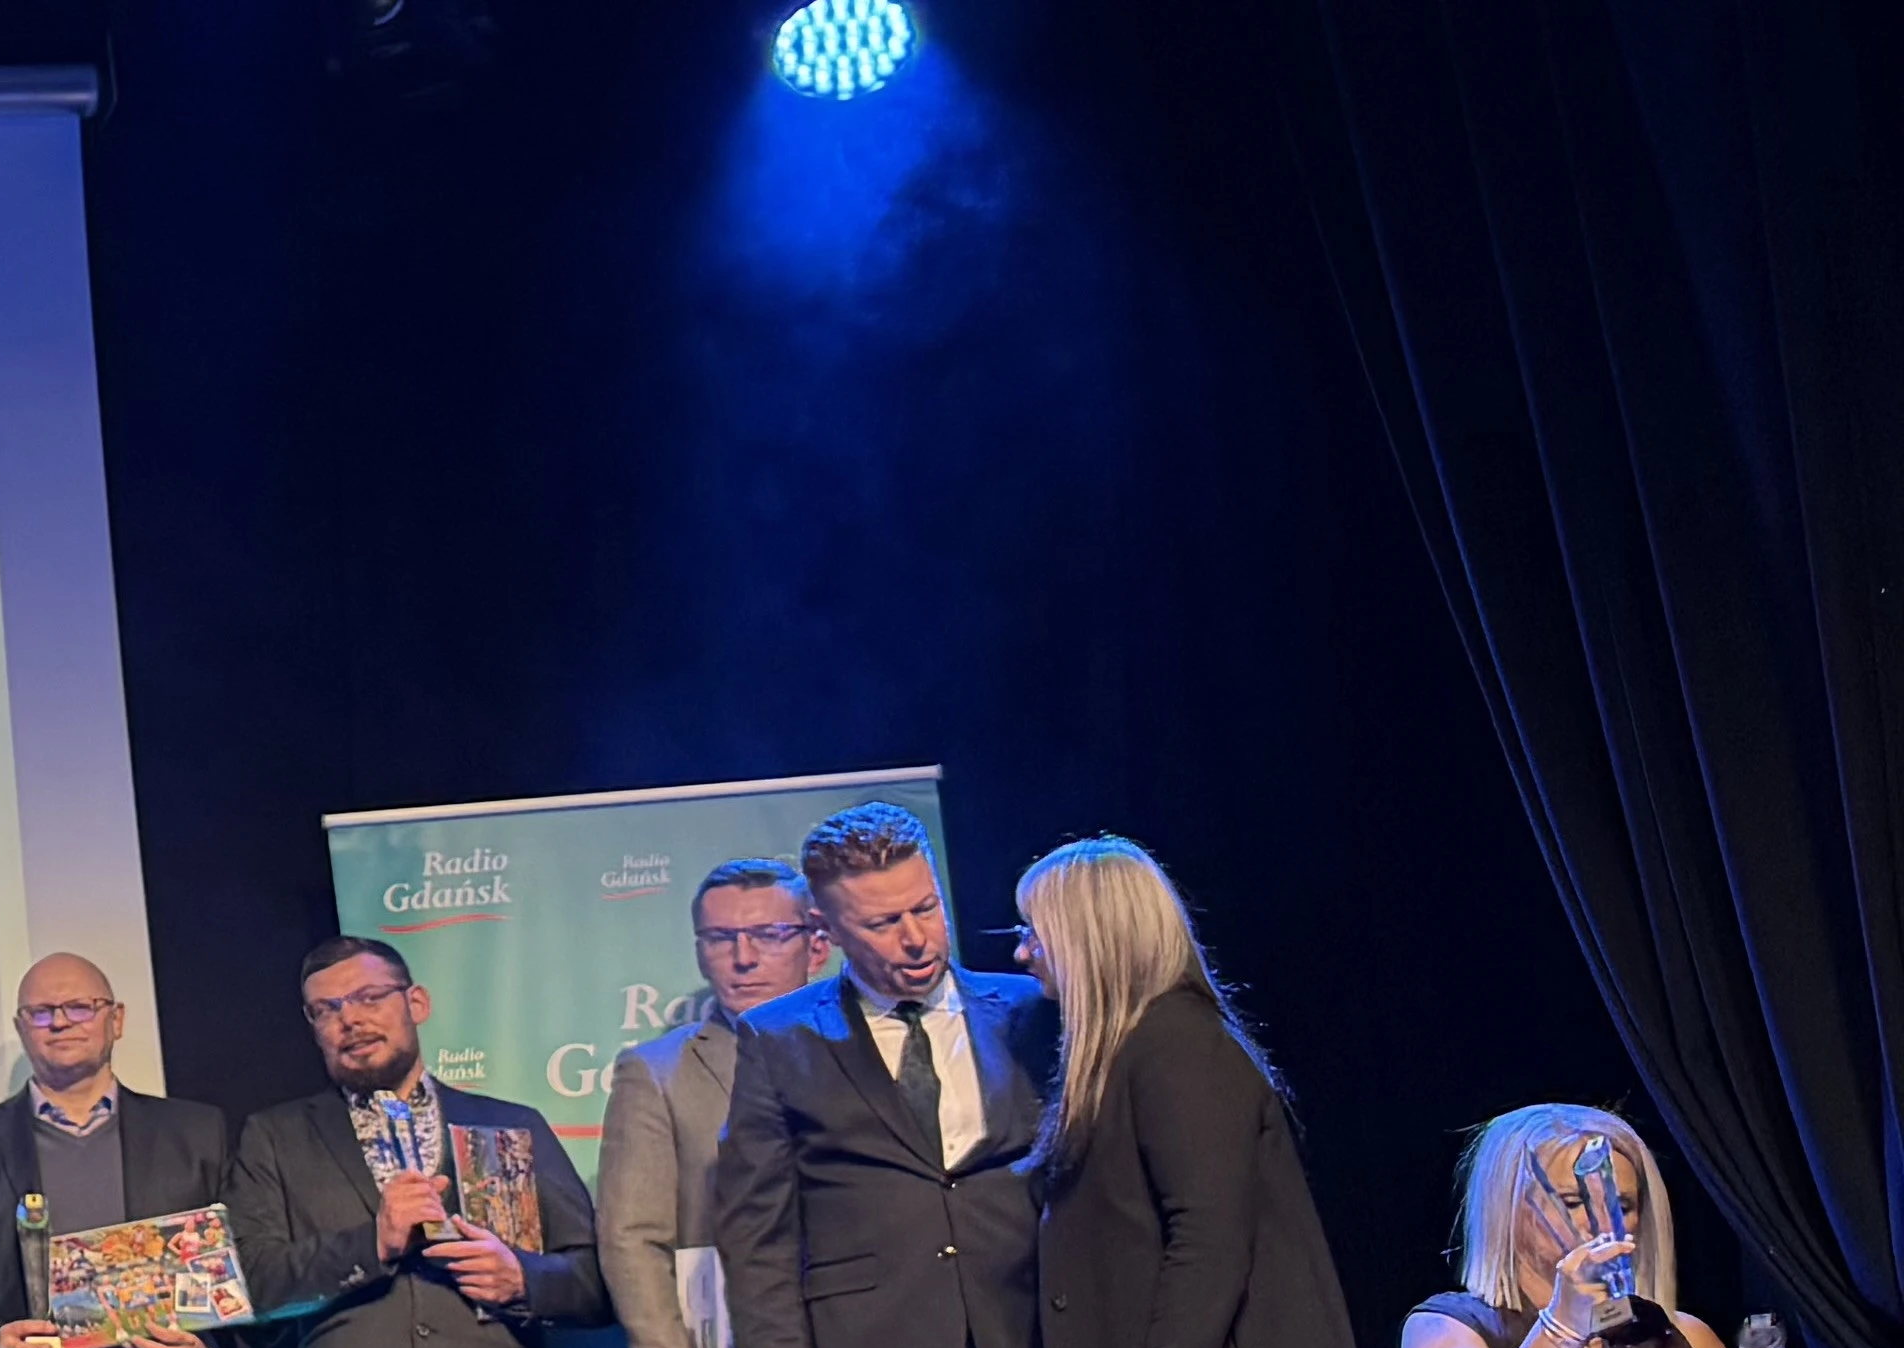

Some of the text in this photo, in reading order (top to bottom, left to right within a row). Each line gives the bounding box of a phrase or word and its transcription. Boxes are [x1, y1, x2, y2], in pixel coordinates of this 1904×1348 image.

[422, 848, 508, 876] Radio
[383, 876, 511, 913] Gdańsk
[430, 1062, 486, 1080] dańsk
